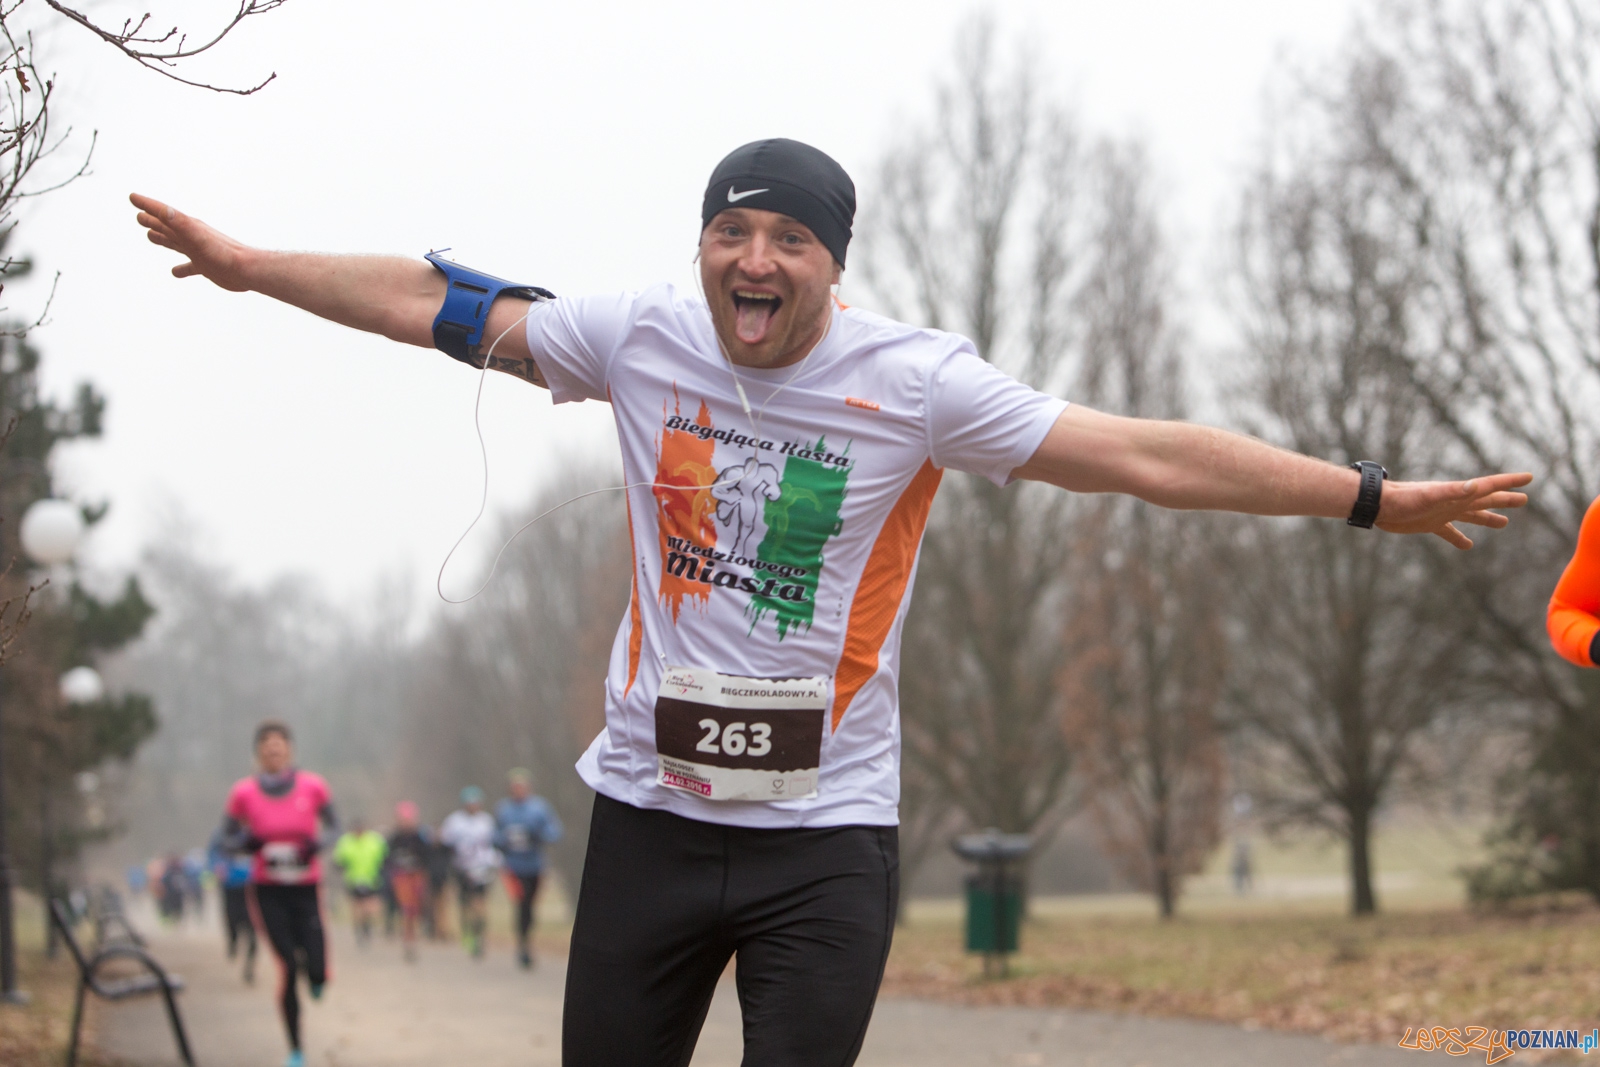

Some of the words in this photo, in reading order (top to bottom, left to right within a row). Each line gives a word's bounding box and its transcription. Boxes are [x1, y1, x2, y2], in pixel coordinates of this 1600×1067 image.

[665, 415, 774, 451] Biegająca
[779, 441, 850, 468] Kasta
[666, 536, 807, 578] Miedziowego
[666, 552, 809, 602] Miasta
[720, 686, 819, 698] BIEGCZEKOLADOWY.PL
[695, 718, 772, 757] 263
